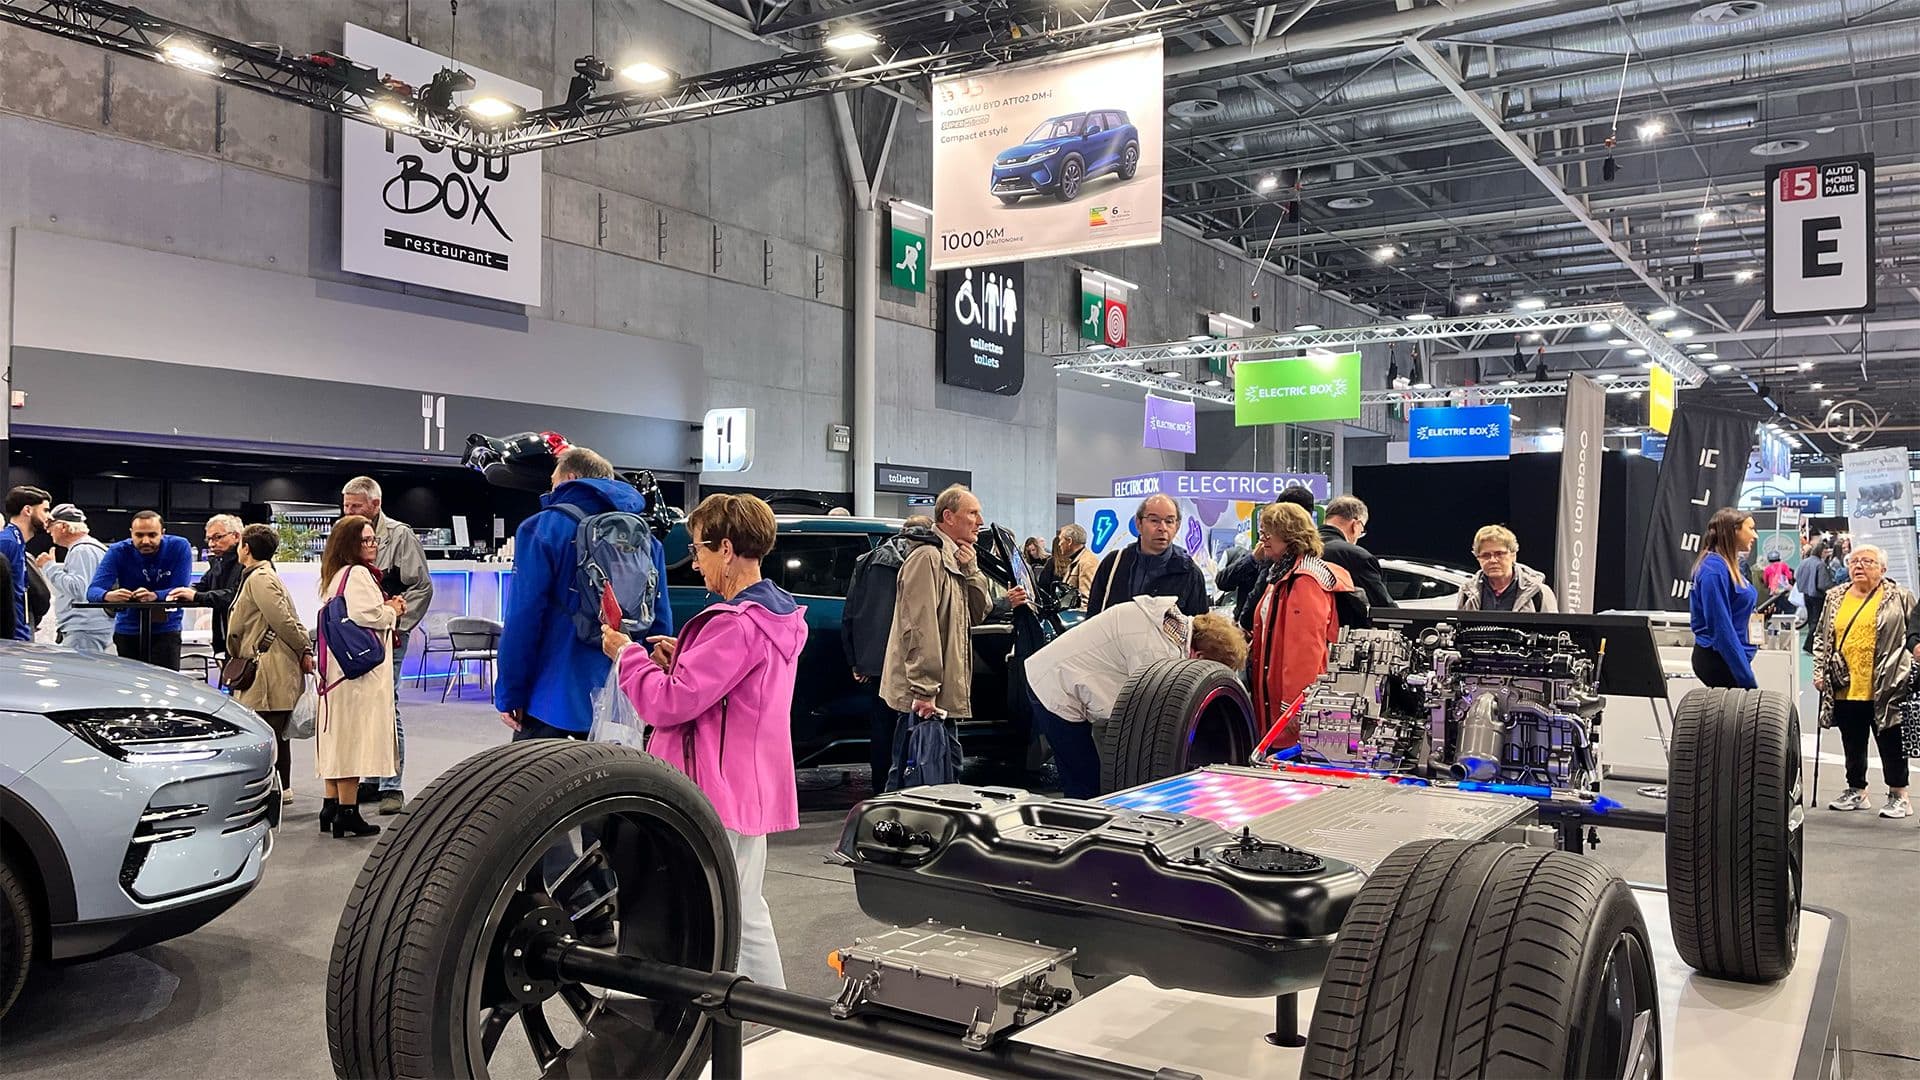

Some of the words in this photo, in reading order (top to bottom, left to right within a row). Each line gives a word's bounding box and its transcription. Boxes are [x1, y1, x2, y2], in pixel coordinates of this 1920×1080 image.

[941, 104, 981, 117] OUVEAU
[983, 100, 1001, 110] BYD
[941, 132, 977, 145] Compact
[979, 130, 987, 139] et
[1826, 165, 1854, 176] AUTO
[1794, 171, 1812, 197] 5
[1825, 175, 1855, 185] MOBIL
[1825, 184, 1855, 195] PARIS
[1111, 206, 1119, 215] 6
[941, 230, 984, 251] 1000
[986, 228, 1004, 239] KM
[1802, 216, 1843, 278] E
[404, 235, 493, 266] restaurant
[970, 337, 1004, 355] toilettes
[974, 353, 1000, 369] toilets
[1259, 385, 1307, 398] ELECTRIC
[1309, 383, 1333, 395] BOX
[1156, 419, 1177, 431] ELECTRIC
[1177, 423, 1187, 432] BOX
[1428, 427, 1467, 437] ELECTRIC
[1469, 426, 1488, 435] BOX
[888, 473, 920, 485] toilettes
[1114, 479, 1143, 497] ELECTRIC
[1143, 477, 1160, 493] BOX
[1178, 475, 1269, 494] ELECTRIC
[1574, 430, 1588, 534] Occasion
[556, 788, 565, 798] R
[566, 779, 582, 792] 22
[584, 773, 592, 783] V
[595, 769, 610, 780] XL
